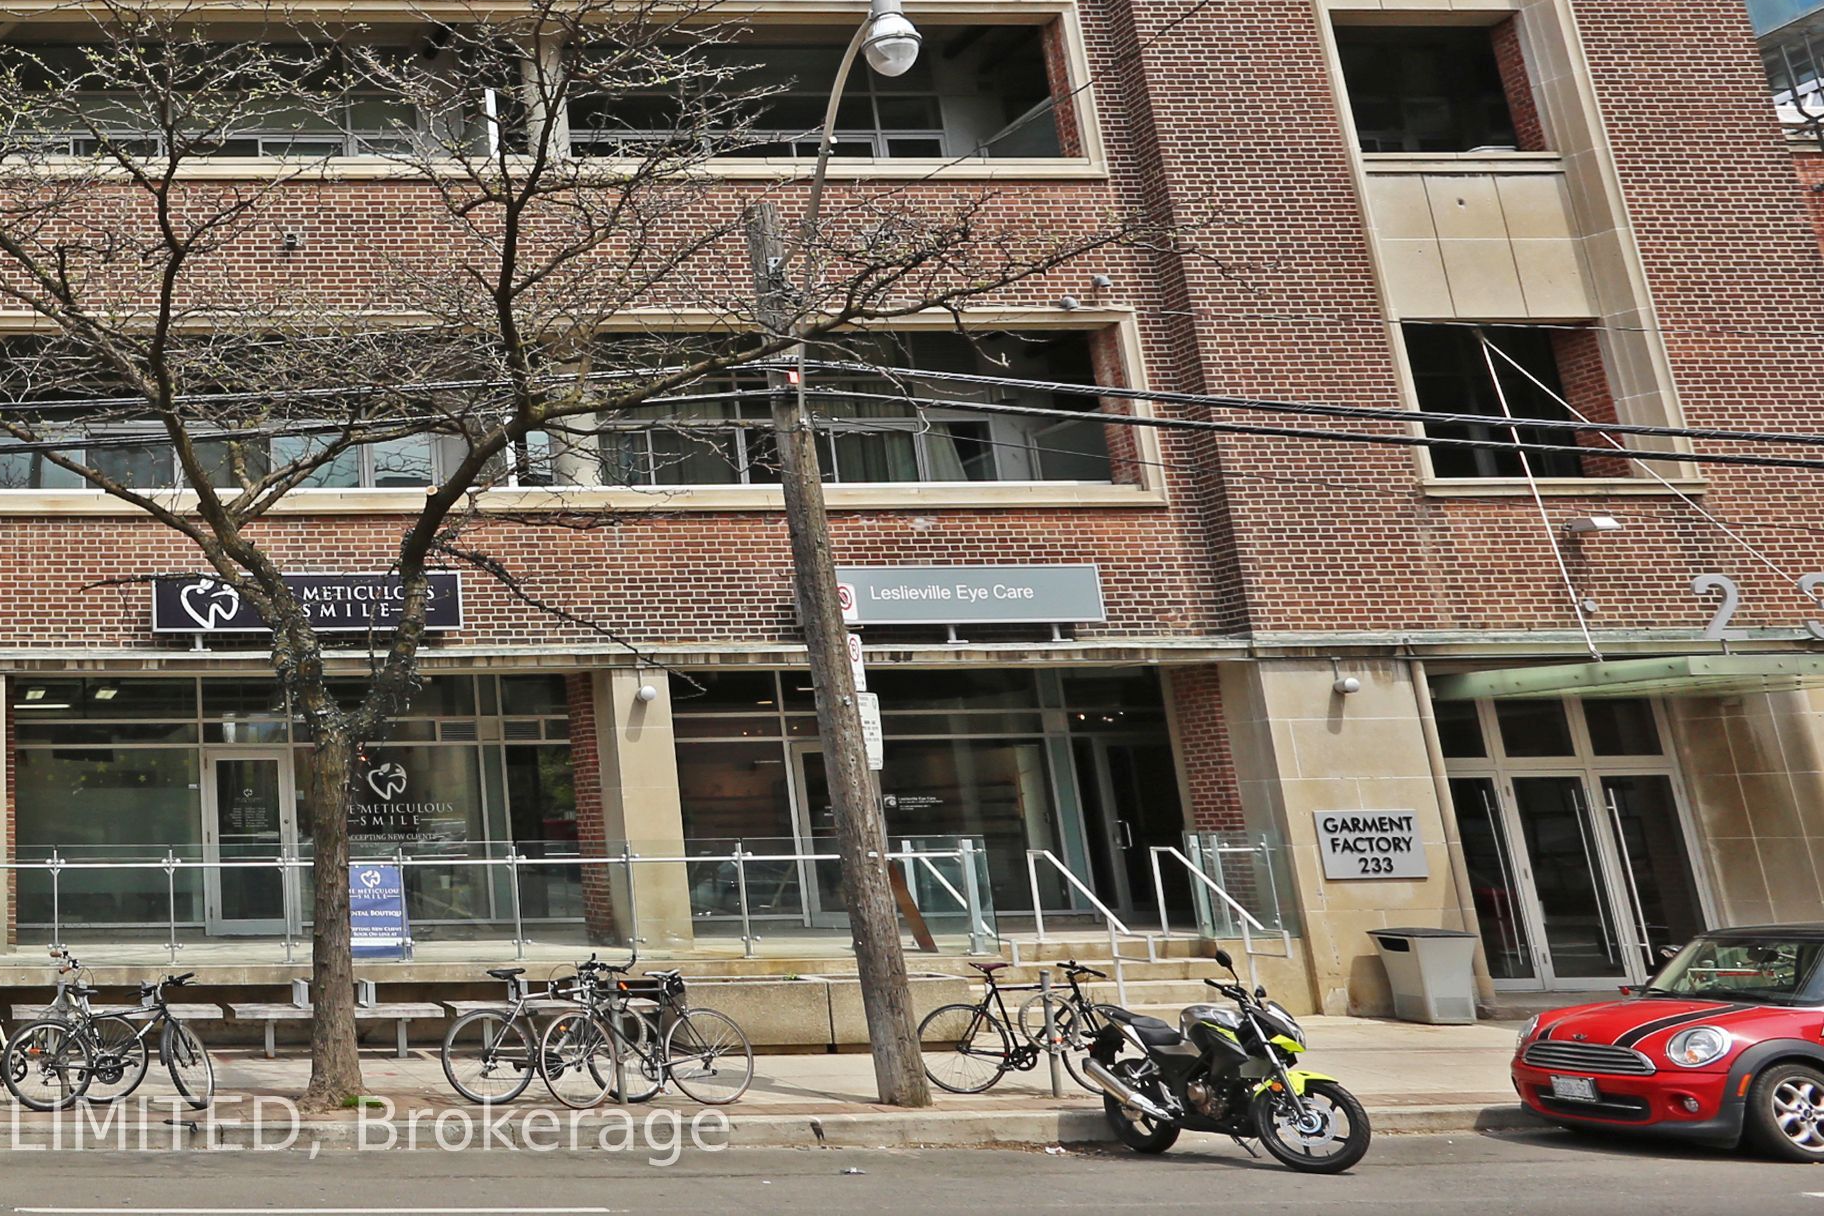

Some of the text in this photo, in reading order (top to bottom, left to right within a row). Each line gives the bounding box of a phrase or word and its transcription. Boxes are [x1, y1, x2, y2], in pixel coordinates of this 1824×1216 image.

[869, 584, 1034, 603] Leslieville Eye Care
[303, 603, 390, 618] SMILE
[360, 802, 454, 814] METICULOUS
[360, 815, 420, 826] SMILE
[1323, 816, 1413, 833] GARMENT
[1330, 836, 1413, 853] FACTORY
[1358, 857, 1394, 874] 233
